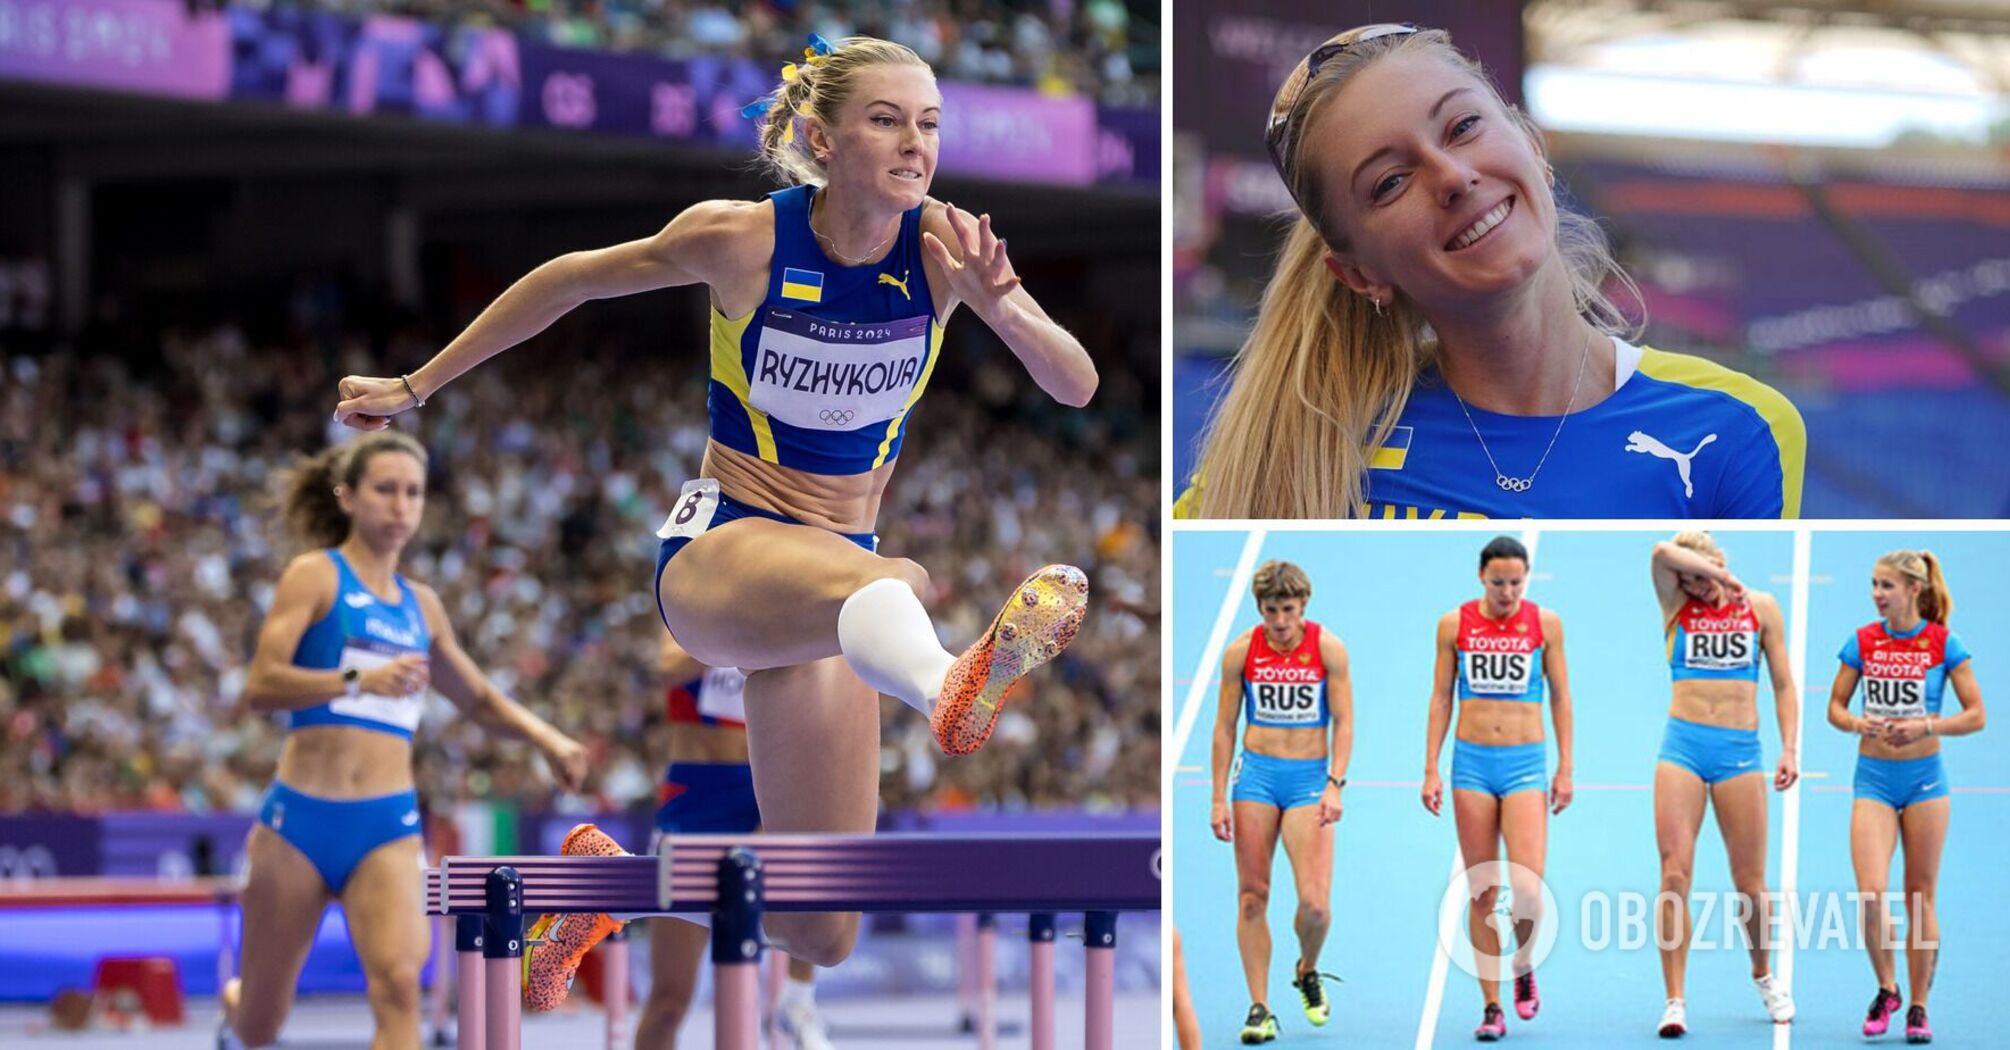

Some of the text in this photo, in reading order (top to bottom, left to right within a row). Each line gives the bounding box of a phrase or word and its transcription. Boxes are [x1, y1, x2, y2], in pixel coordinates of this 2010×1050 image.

[810, 322, 891, 340] PARIS 2024
[759, 349, 918, 396] RYZHYKOVA
[675, 490, 703, 525] 8
[1689, 618, 1752, 631] TOYOTA
[1468, 636, 1531, 651] TOYOTA
[1693, 632, 1747, 659] RUS
[1471, 653, 1526, 681] RUS
[1259, 684, 1314, 711] RUS
[1867, 679, 1919, 706] RUS
